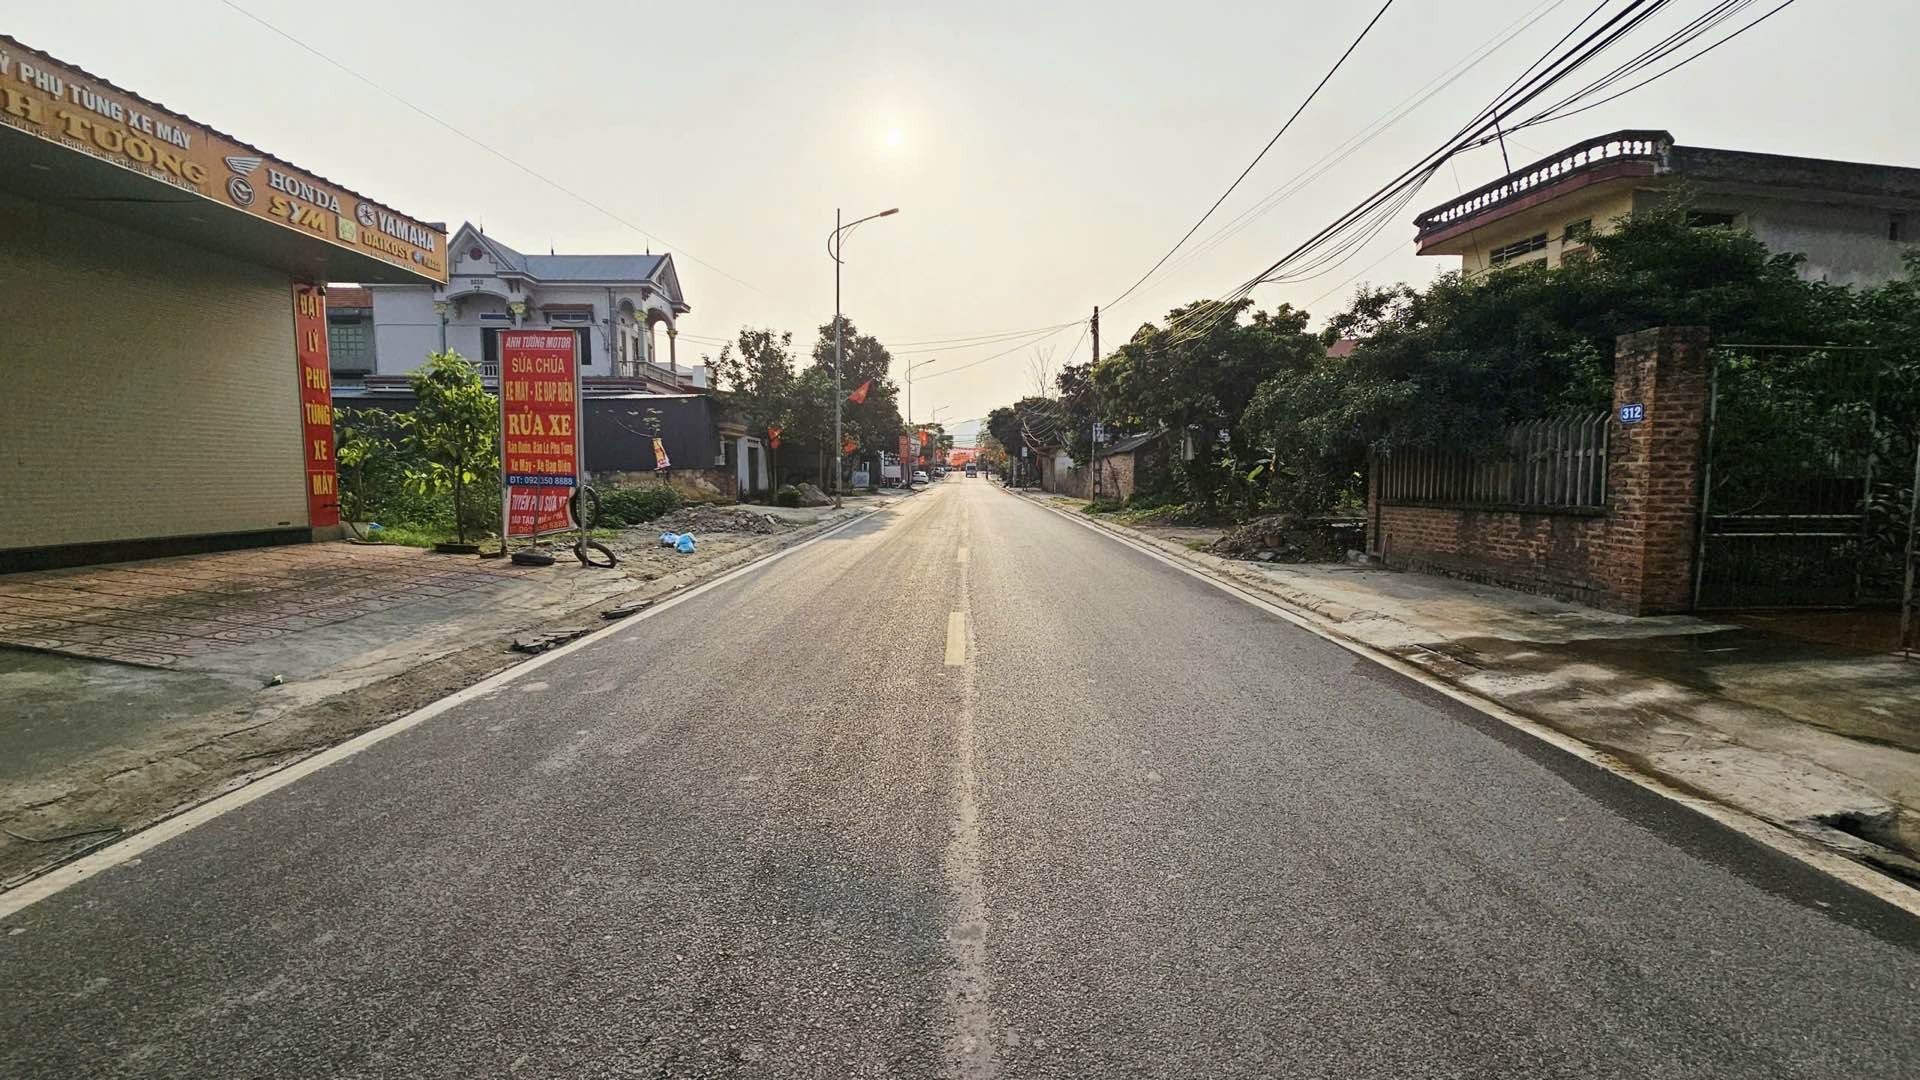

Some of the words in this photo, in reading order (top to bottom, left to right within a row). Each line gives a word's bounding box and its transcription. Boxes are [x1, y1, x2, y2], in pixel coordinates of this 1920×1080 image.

[20, 62, 64, 100] PHỤ
[69, 84, 123, 121] TÙNG
[128, 109, 152, 134] XE
[156, 122, 193, 150] MÁY
[268, 168, 342, 214] HONDA
[270, 195, 327, 232] SYM
[377, 210, 435, 252] YAMAHA
[299, 293, 321, 320] ĐẠI
[308, 328, 319, 353] LÝ
[506, 336, 521, 348] ANH
[545, 336, 572, 349] MOTOR
[511, 352, 533, 373] SỬA
[535, 354, 566, 373] CHỮA
[305, 366, 328, 394] PHỤ
[505, 380, 514, 401] XE
[515, 378, 529, 401] MÁY
[534, 381, 543, 401] XE
[543, 381, 557, 406] ĐẠP
[557, 378, 573, 406] ĐIỆN
[305, 400, 331, 426] TÙNG
[508, 405, 545, 436] RỬA
[549, 414, 572, 436] XE
[1622, 406, 1641, 419] 312
[313, 439, 328, 460] XE
[312, 471, 333, 496] MÁY
[510, 476, 523, 485] ĐT:
[524, 477, 538, 485] 092
